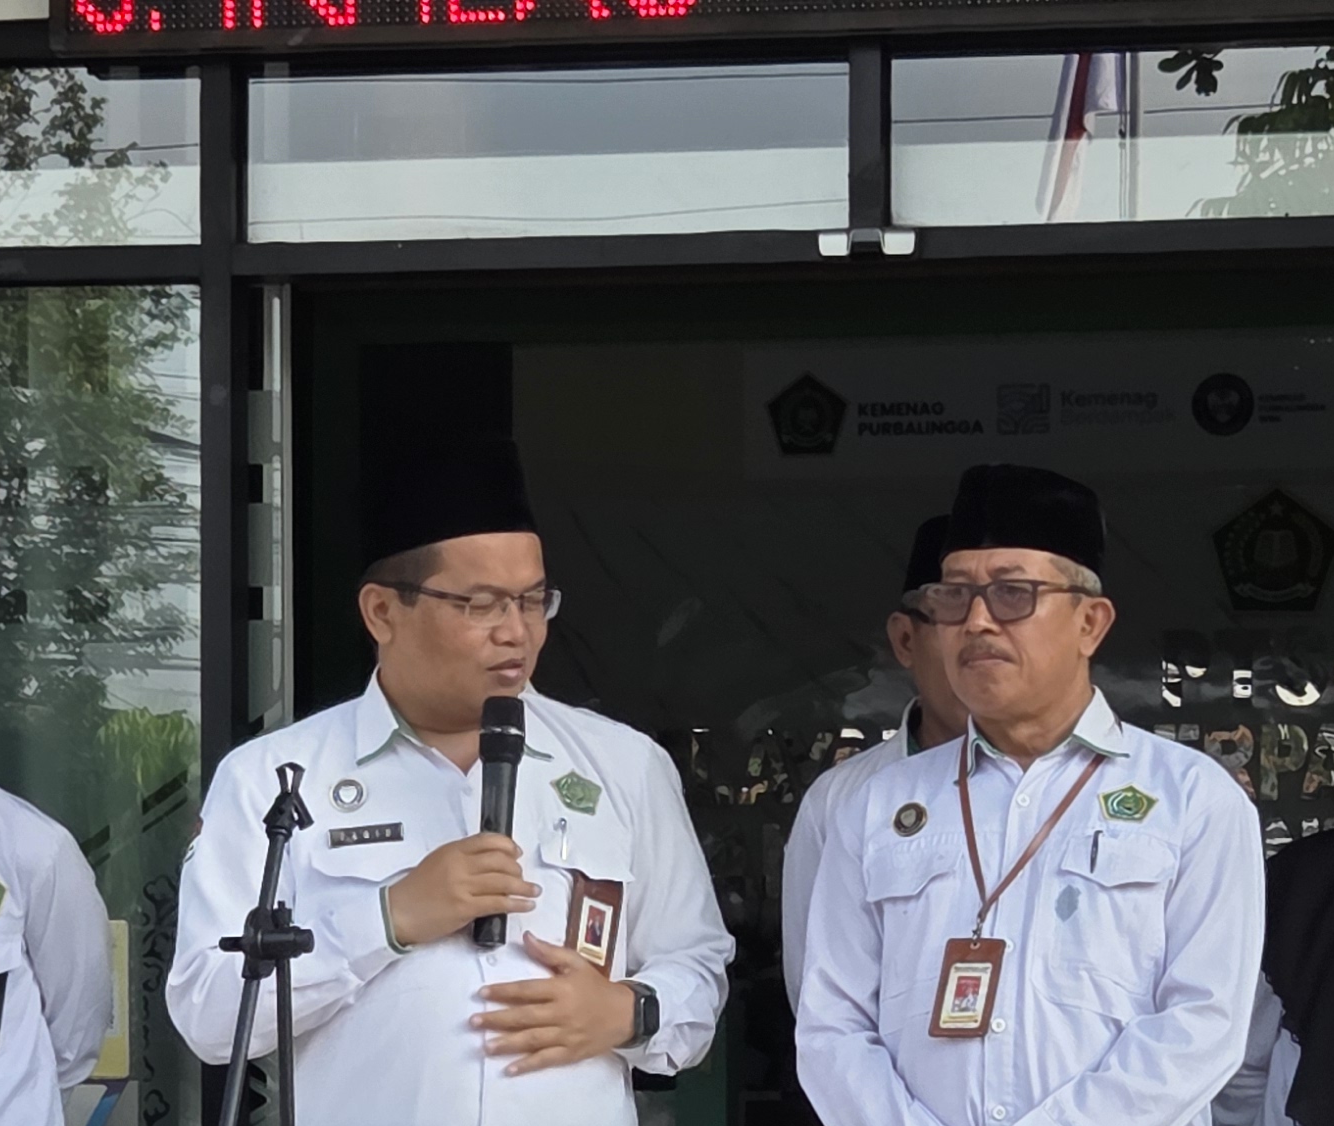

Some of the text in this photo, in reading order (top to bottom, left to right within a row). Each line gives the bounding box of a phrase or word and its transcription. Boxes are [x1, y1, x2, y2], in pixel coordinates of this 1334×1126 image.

[1060, 389, 1159, 410] Kemenag
[857, 401, 945, 417] KEMENAG
[857, 418, 984, 436] PURBALINGGA
